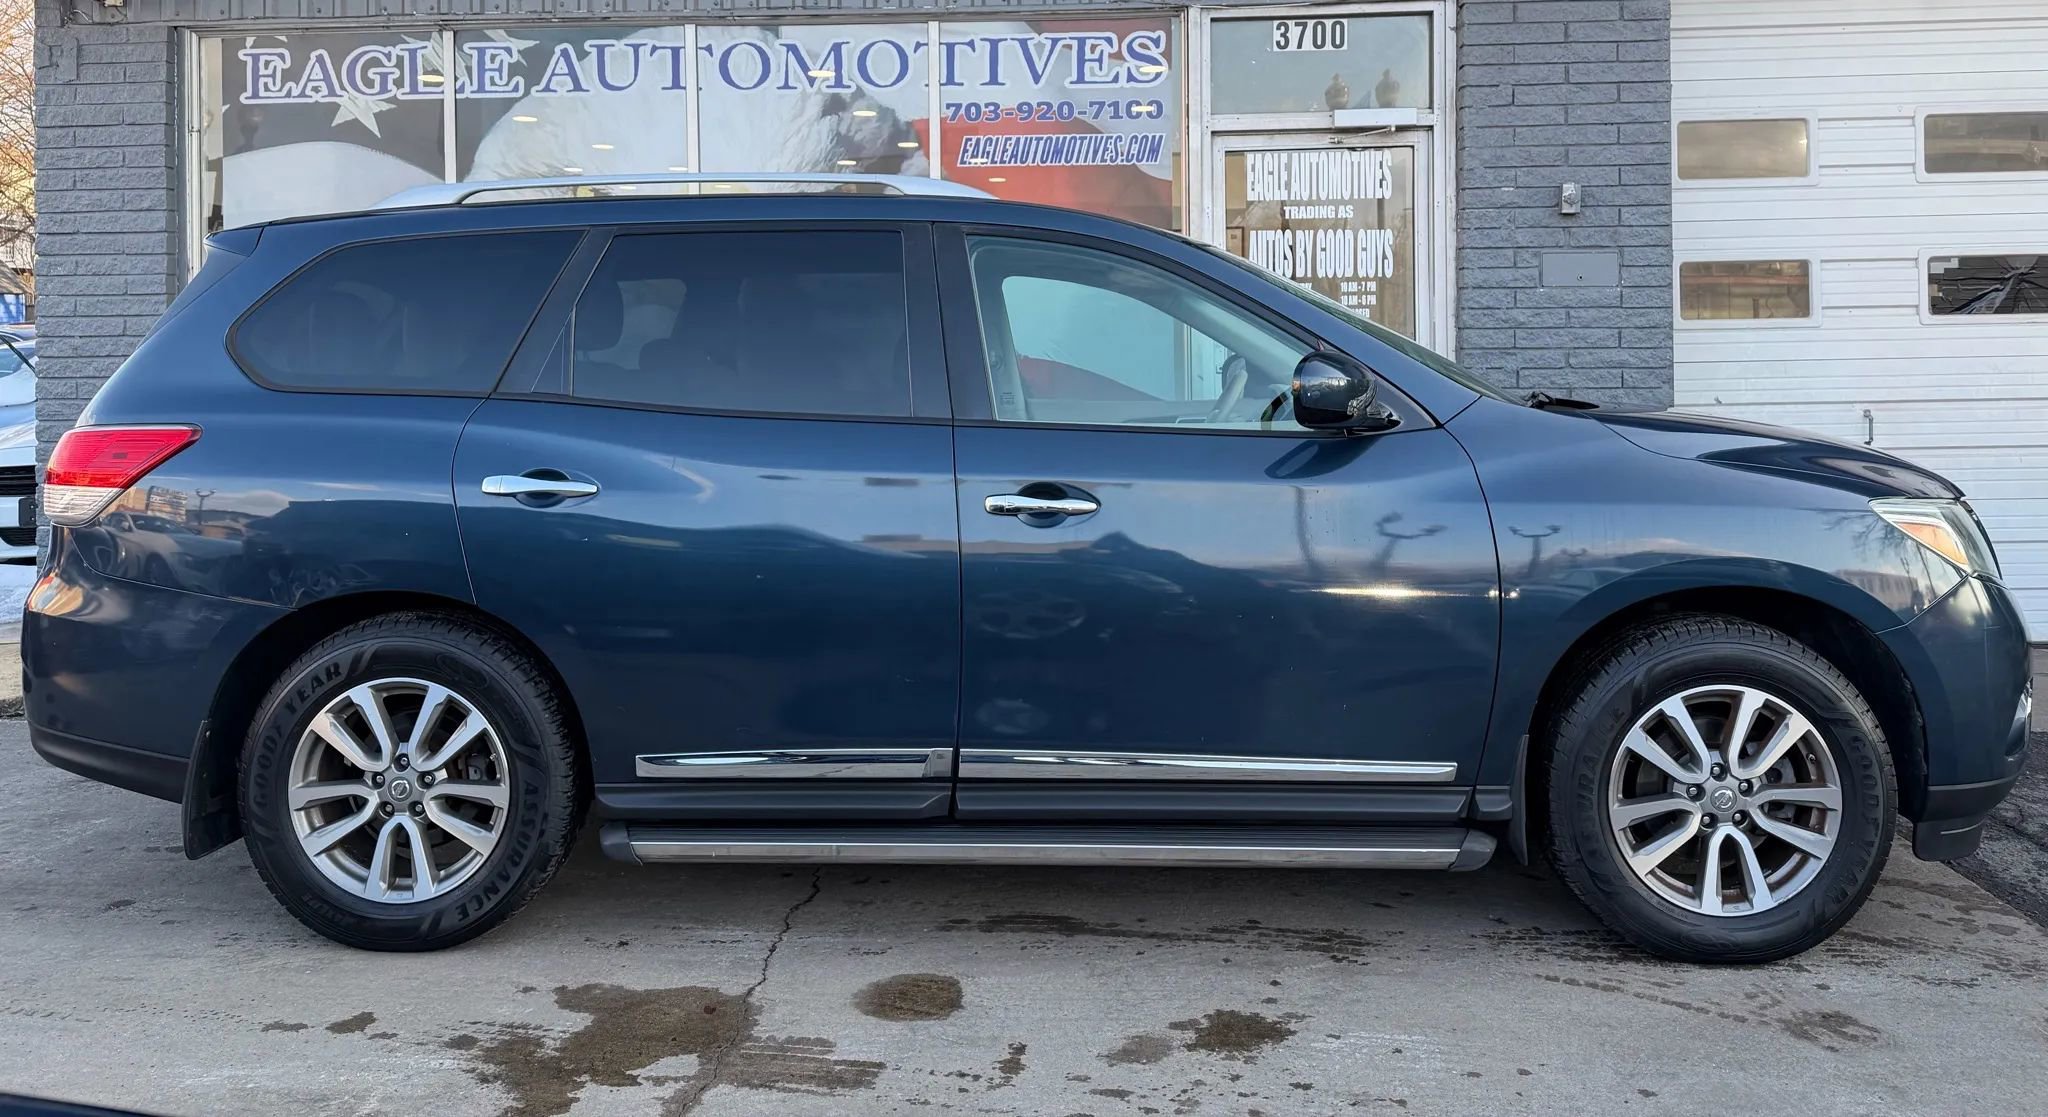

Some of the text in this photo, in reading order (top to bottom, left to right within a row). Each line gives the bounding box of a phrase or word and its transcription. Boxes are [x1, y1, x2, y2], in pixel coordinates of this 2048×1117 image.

[1275, 20, 1346, 50] 3700
[241, 31, 1168, 102] EAGLE AUTOMOTIVES
[946, 99, 1165, 123] 703-920-7100
[957, 133, 1166, 168] EAGLEAUTOMOTIVES.COM
[1247, 149, 1393, 201] EAGLE AUTOMOTIVES
[1284, 206, 1354, 219] TRADING AS
[1248, 228, 1393, 279] AUTOS BY GOOD GUYS
[1340, 281, 1347, 292] 10
[1348, 281, 1358, 292] AM
[1361, 281, 1365, 292] 7
[1366, 281, 1376, 292] PM
[1340, 295, 1348, 305] 10
[1348, 295, 1358, 305] AM
[1366, 294, 1376, 305] PM
[459, 779, 539, 924] ASSURANCE
